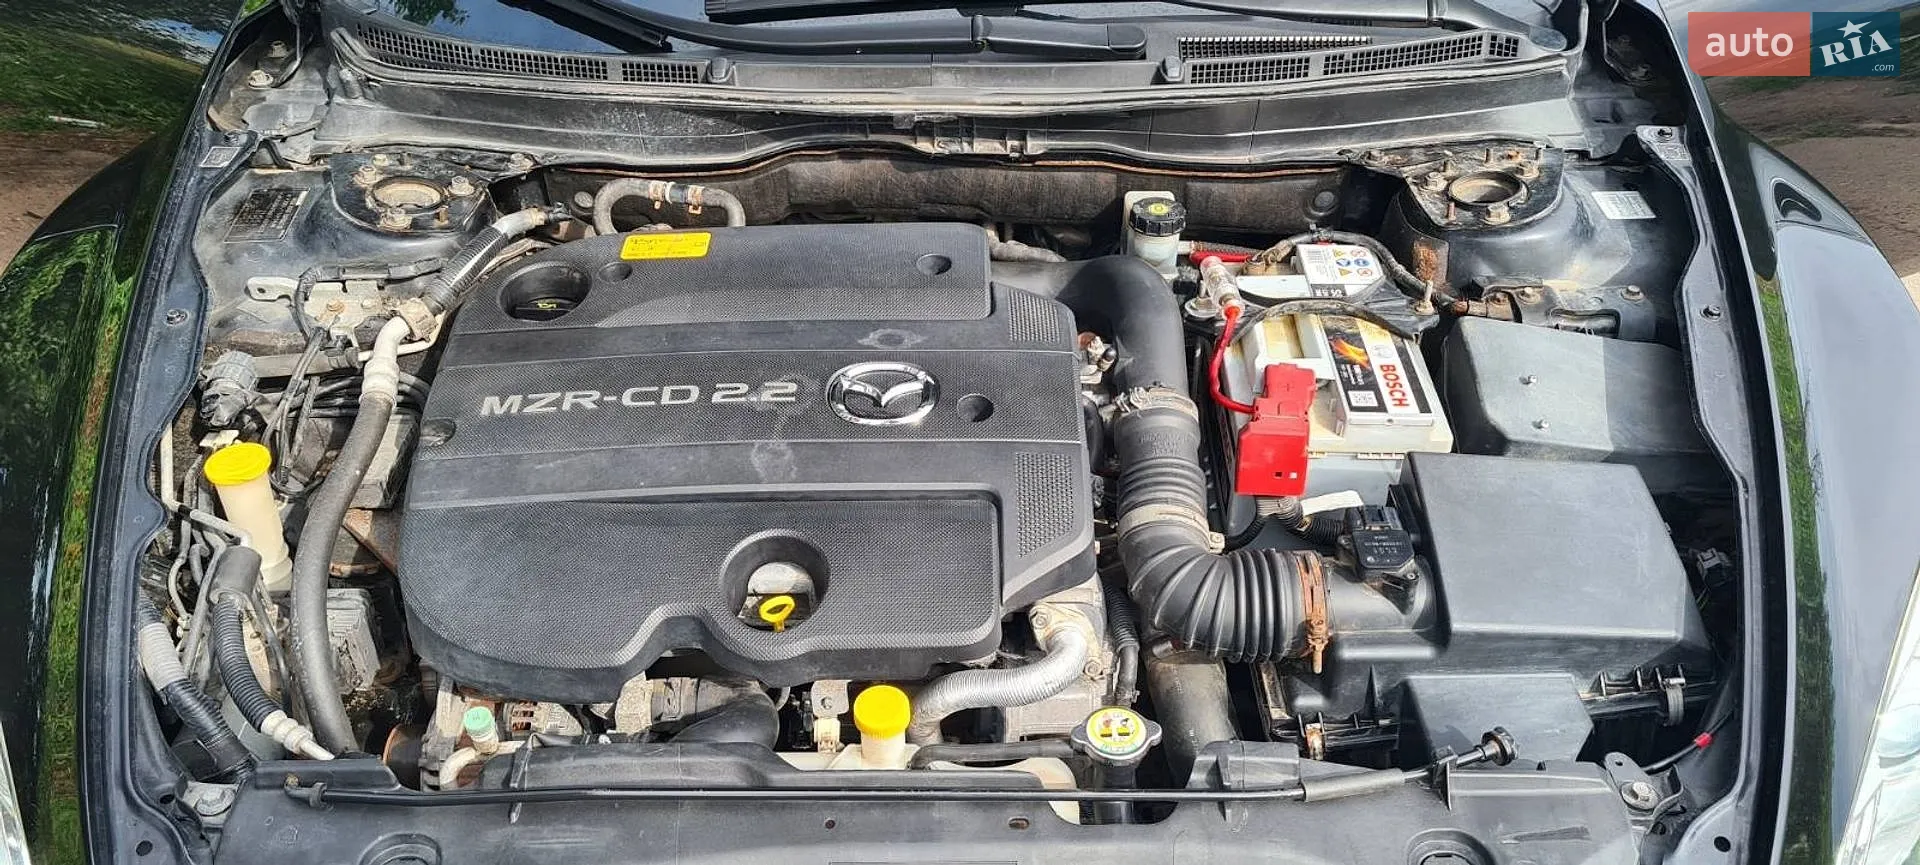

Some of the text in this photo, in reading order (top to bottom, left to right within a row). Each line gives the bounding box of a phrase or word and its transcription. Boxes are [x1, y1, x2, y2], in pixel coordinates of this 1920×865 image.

[480, 382, 798, 416] MZR-CD 2.2
[1379, 364, 1410, 408] BOSCH
